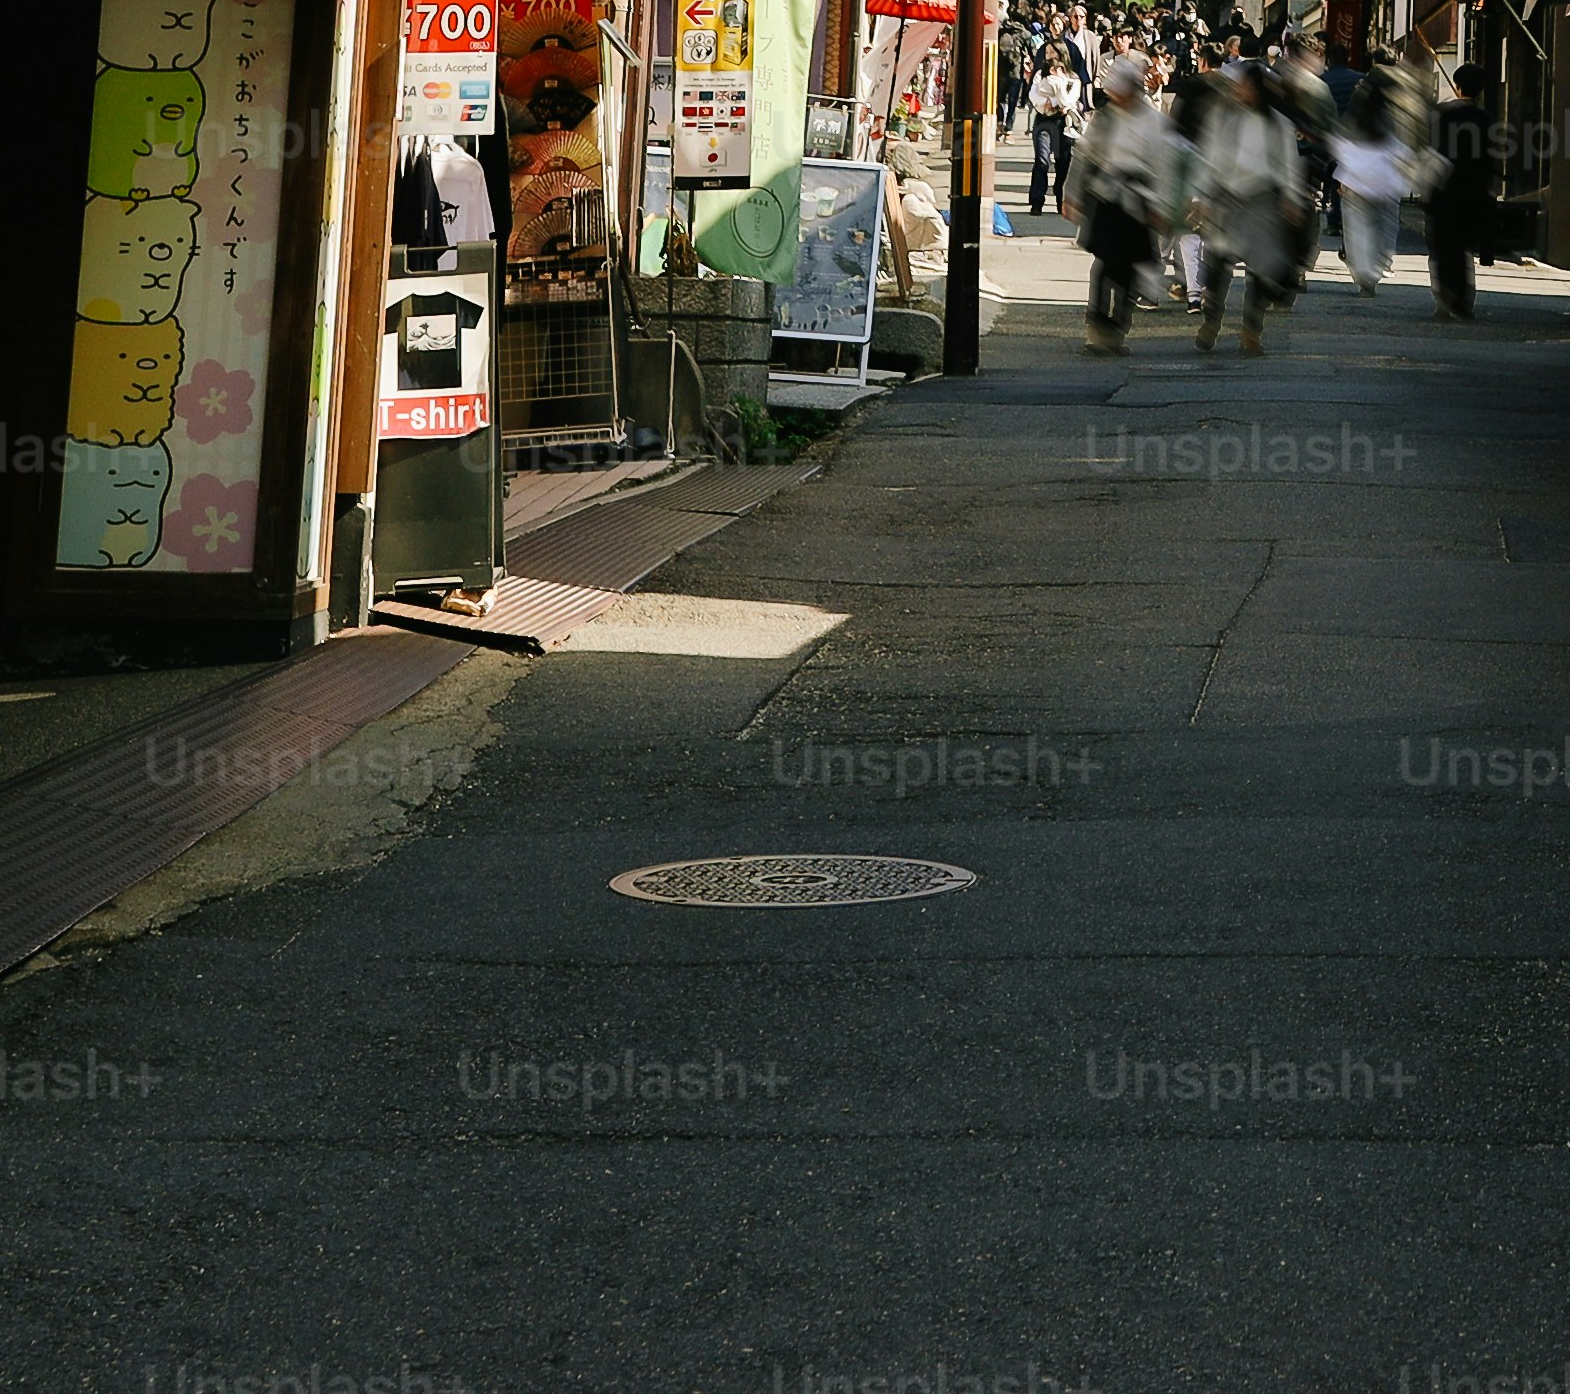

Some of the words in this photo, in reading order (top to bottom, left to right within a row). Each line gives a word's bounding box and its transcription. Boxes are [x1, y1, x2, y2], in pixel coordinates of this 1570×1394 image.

[415, 62, 443, 73] Cards
[445, 62, 488, 74] Accepted
[379, 397, 486, 437] T-shirt
